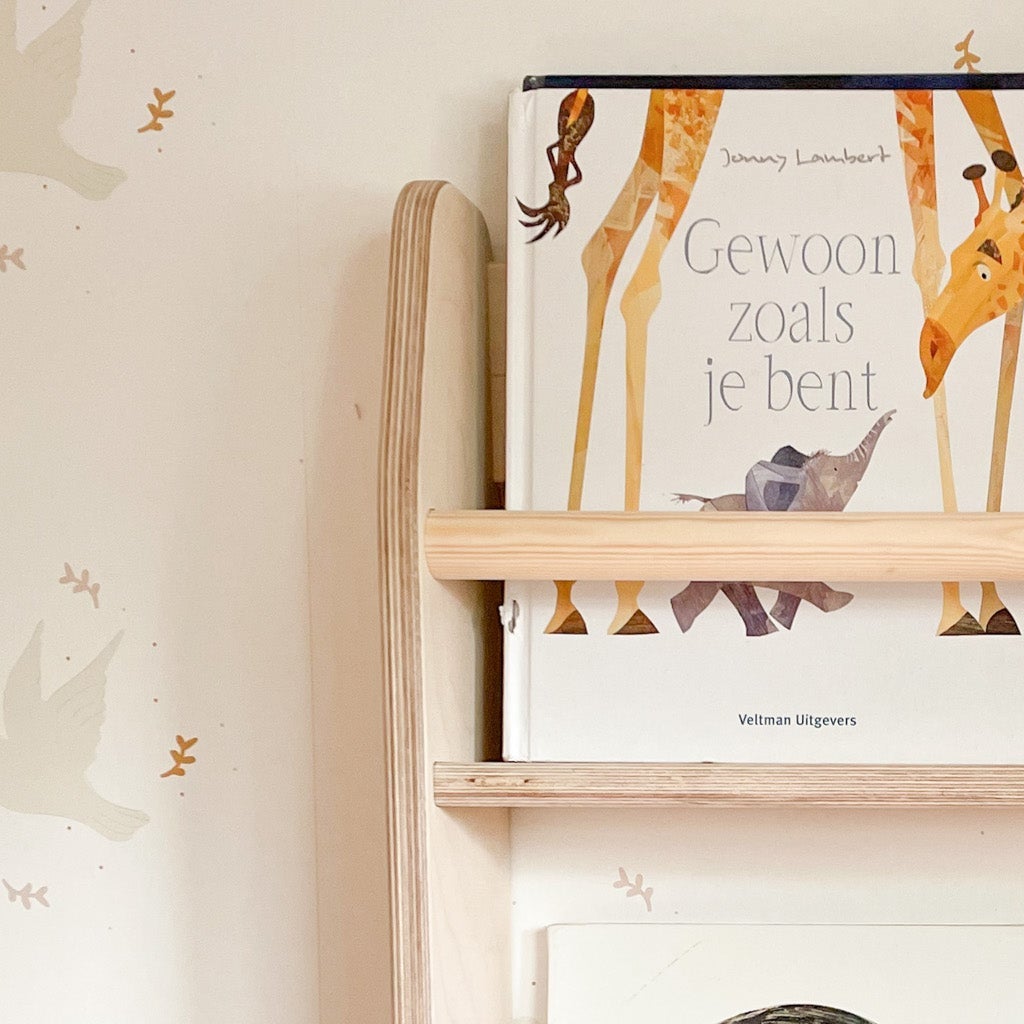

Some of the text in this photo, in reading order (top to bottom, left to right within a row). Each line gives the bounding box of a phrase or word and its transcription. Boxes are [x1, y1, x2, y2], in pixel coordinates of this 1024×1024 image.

[720, 145, 891, 173] Jonny Lambert
[684, 217, 901, 276] Gewoon
[728, 286, 855, 344] zoals
[703, 354, 879, 427] je bent
[738, 713, 857, 729] Veltman Uitgevers
